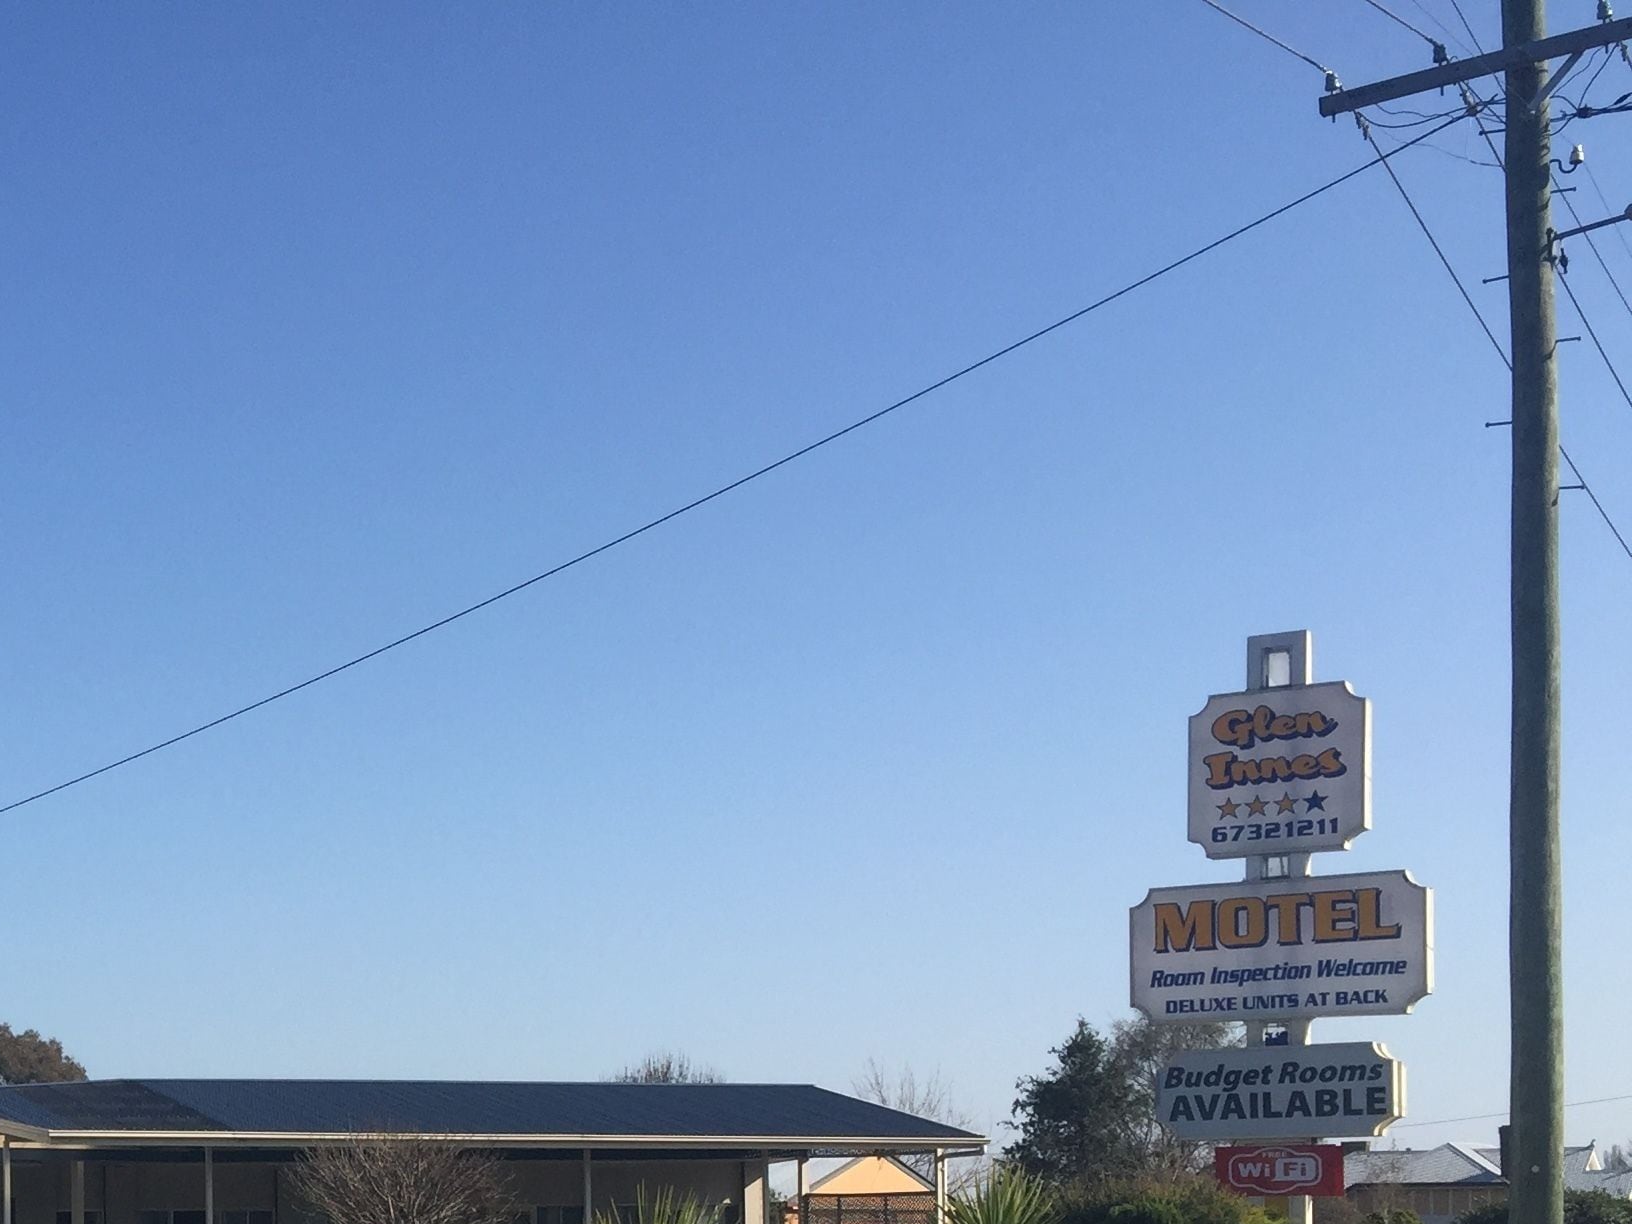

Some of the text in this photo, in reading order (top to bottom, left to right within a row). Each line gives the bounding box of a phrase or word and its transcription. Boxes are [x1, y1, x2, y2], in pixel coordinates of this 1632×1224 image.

[1211, 704, 1338, 749] Glen
[1203, 746, 1348, 790] Innes
[1211, 817, 1339, 843] 67321211
[1153, 887, 1404, 954] MOTEL
[1150, 958, 1407, 988] Room Inspection Welcome
[1165, 988, 1389, 1014] DELUXE UNITS AT BACK
[1164, 1061, 1384, 1092] Budget Rooms
[1169, 1086, 1388, 1122] AVAILABLE
